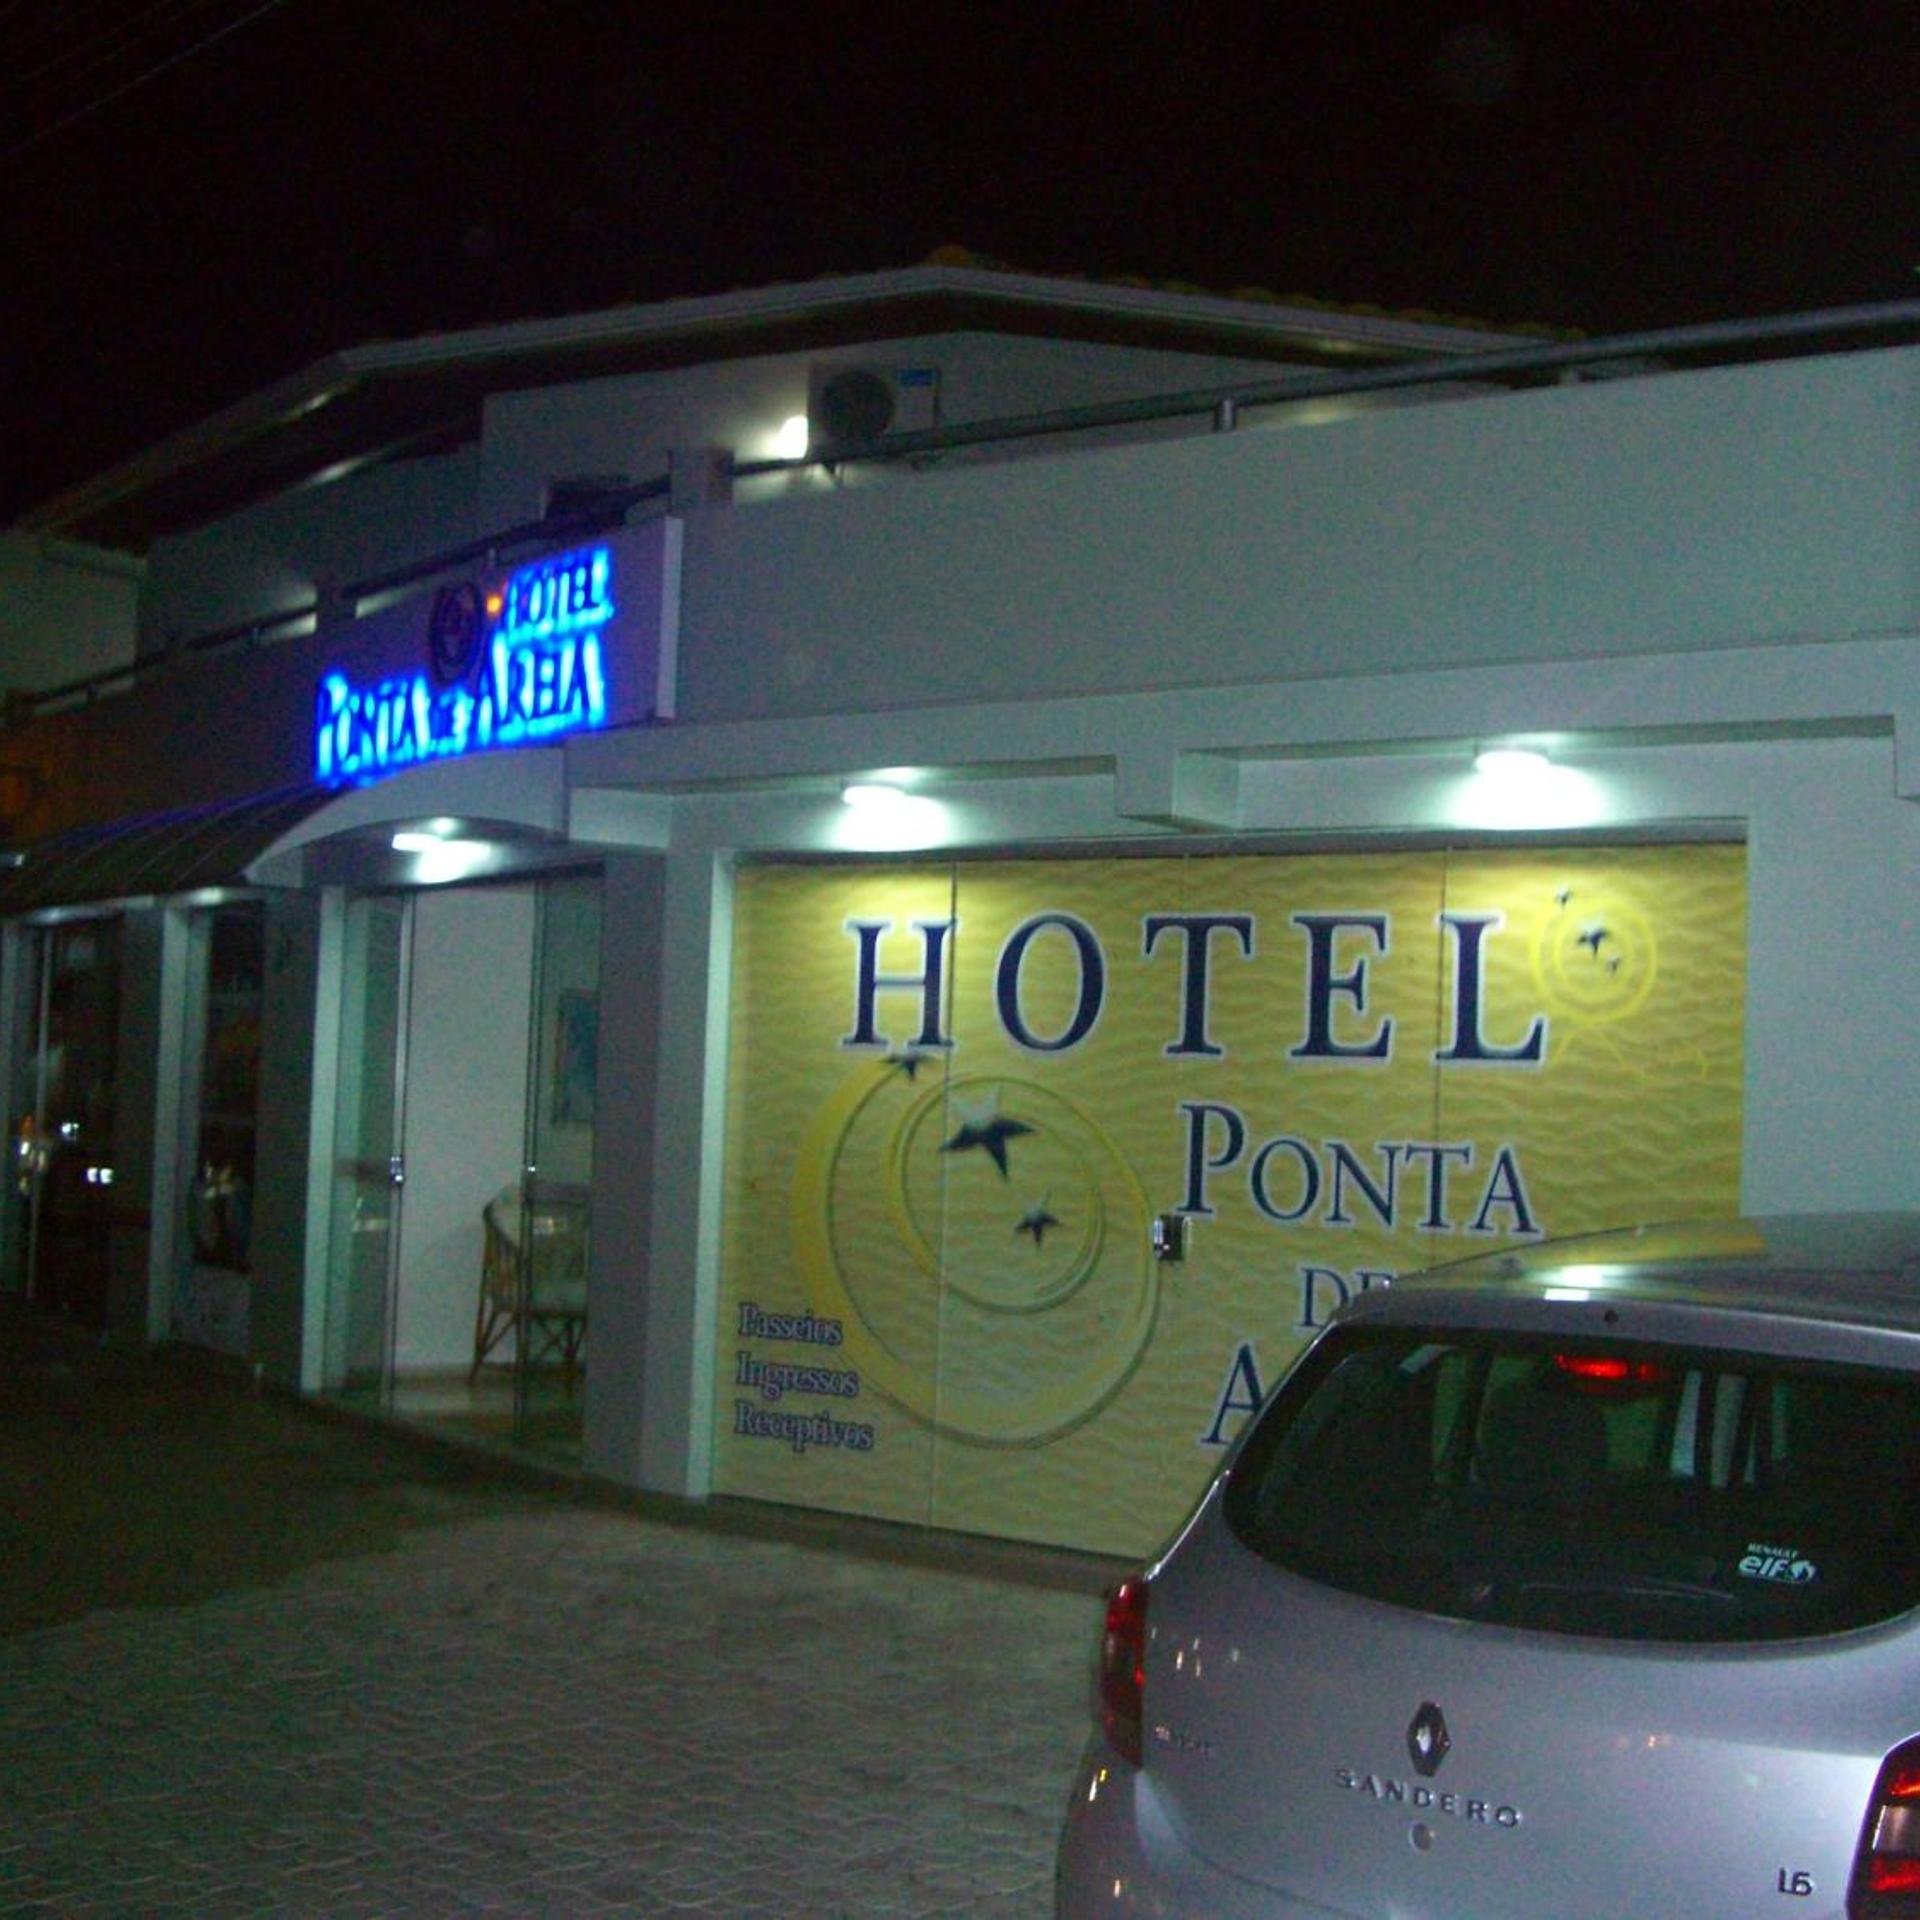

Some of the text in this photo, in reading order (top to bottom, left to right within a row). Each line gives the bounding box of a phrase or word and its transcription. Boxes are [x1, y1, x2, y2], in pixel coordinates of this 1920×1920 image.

[841, 912, 1546, 1062] HOTEL
[1177, 1102, 1543, 1236] PONTA
[738, 1302, 842, 1346] Passeios
[1297, 1267, 1394, 1328] D
[736, 1351, 860, 1399] Ingressos
[734, 1400, 874, 1453] Receptivos
[1335, 1768, 1523, 1828] SANDERO
